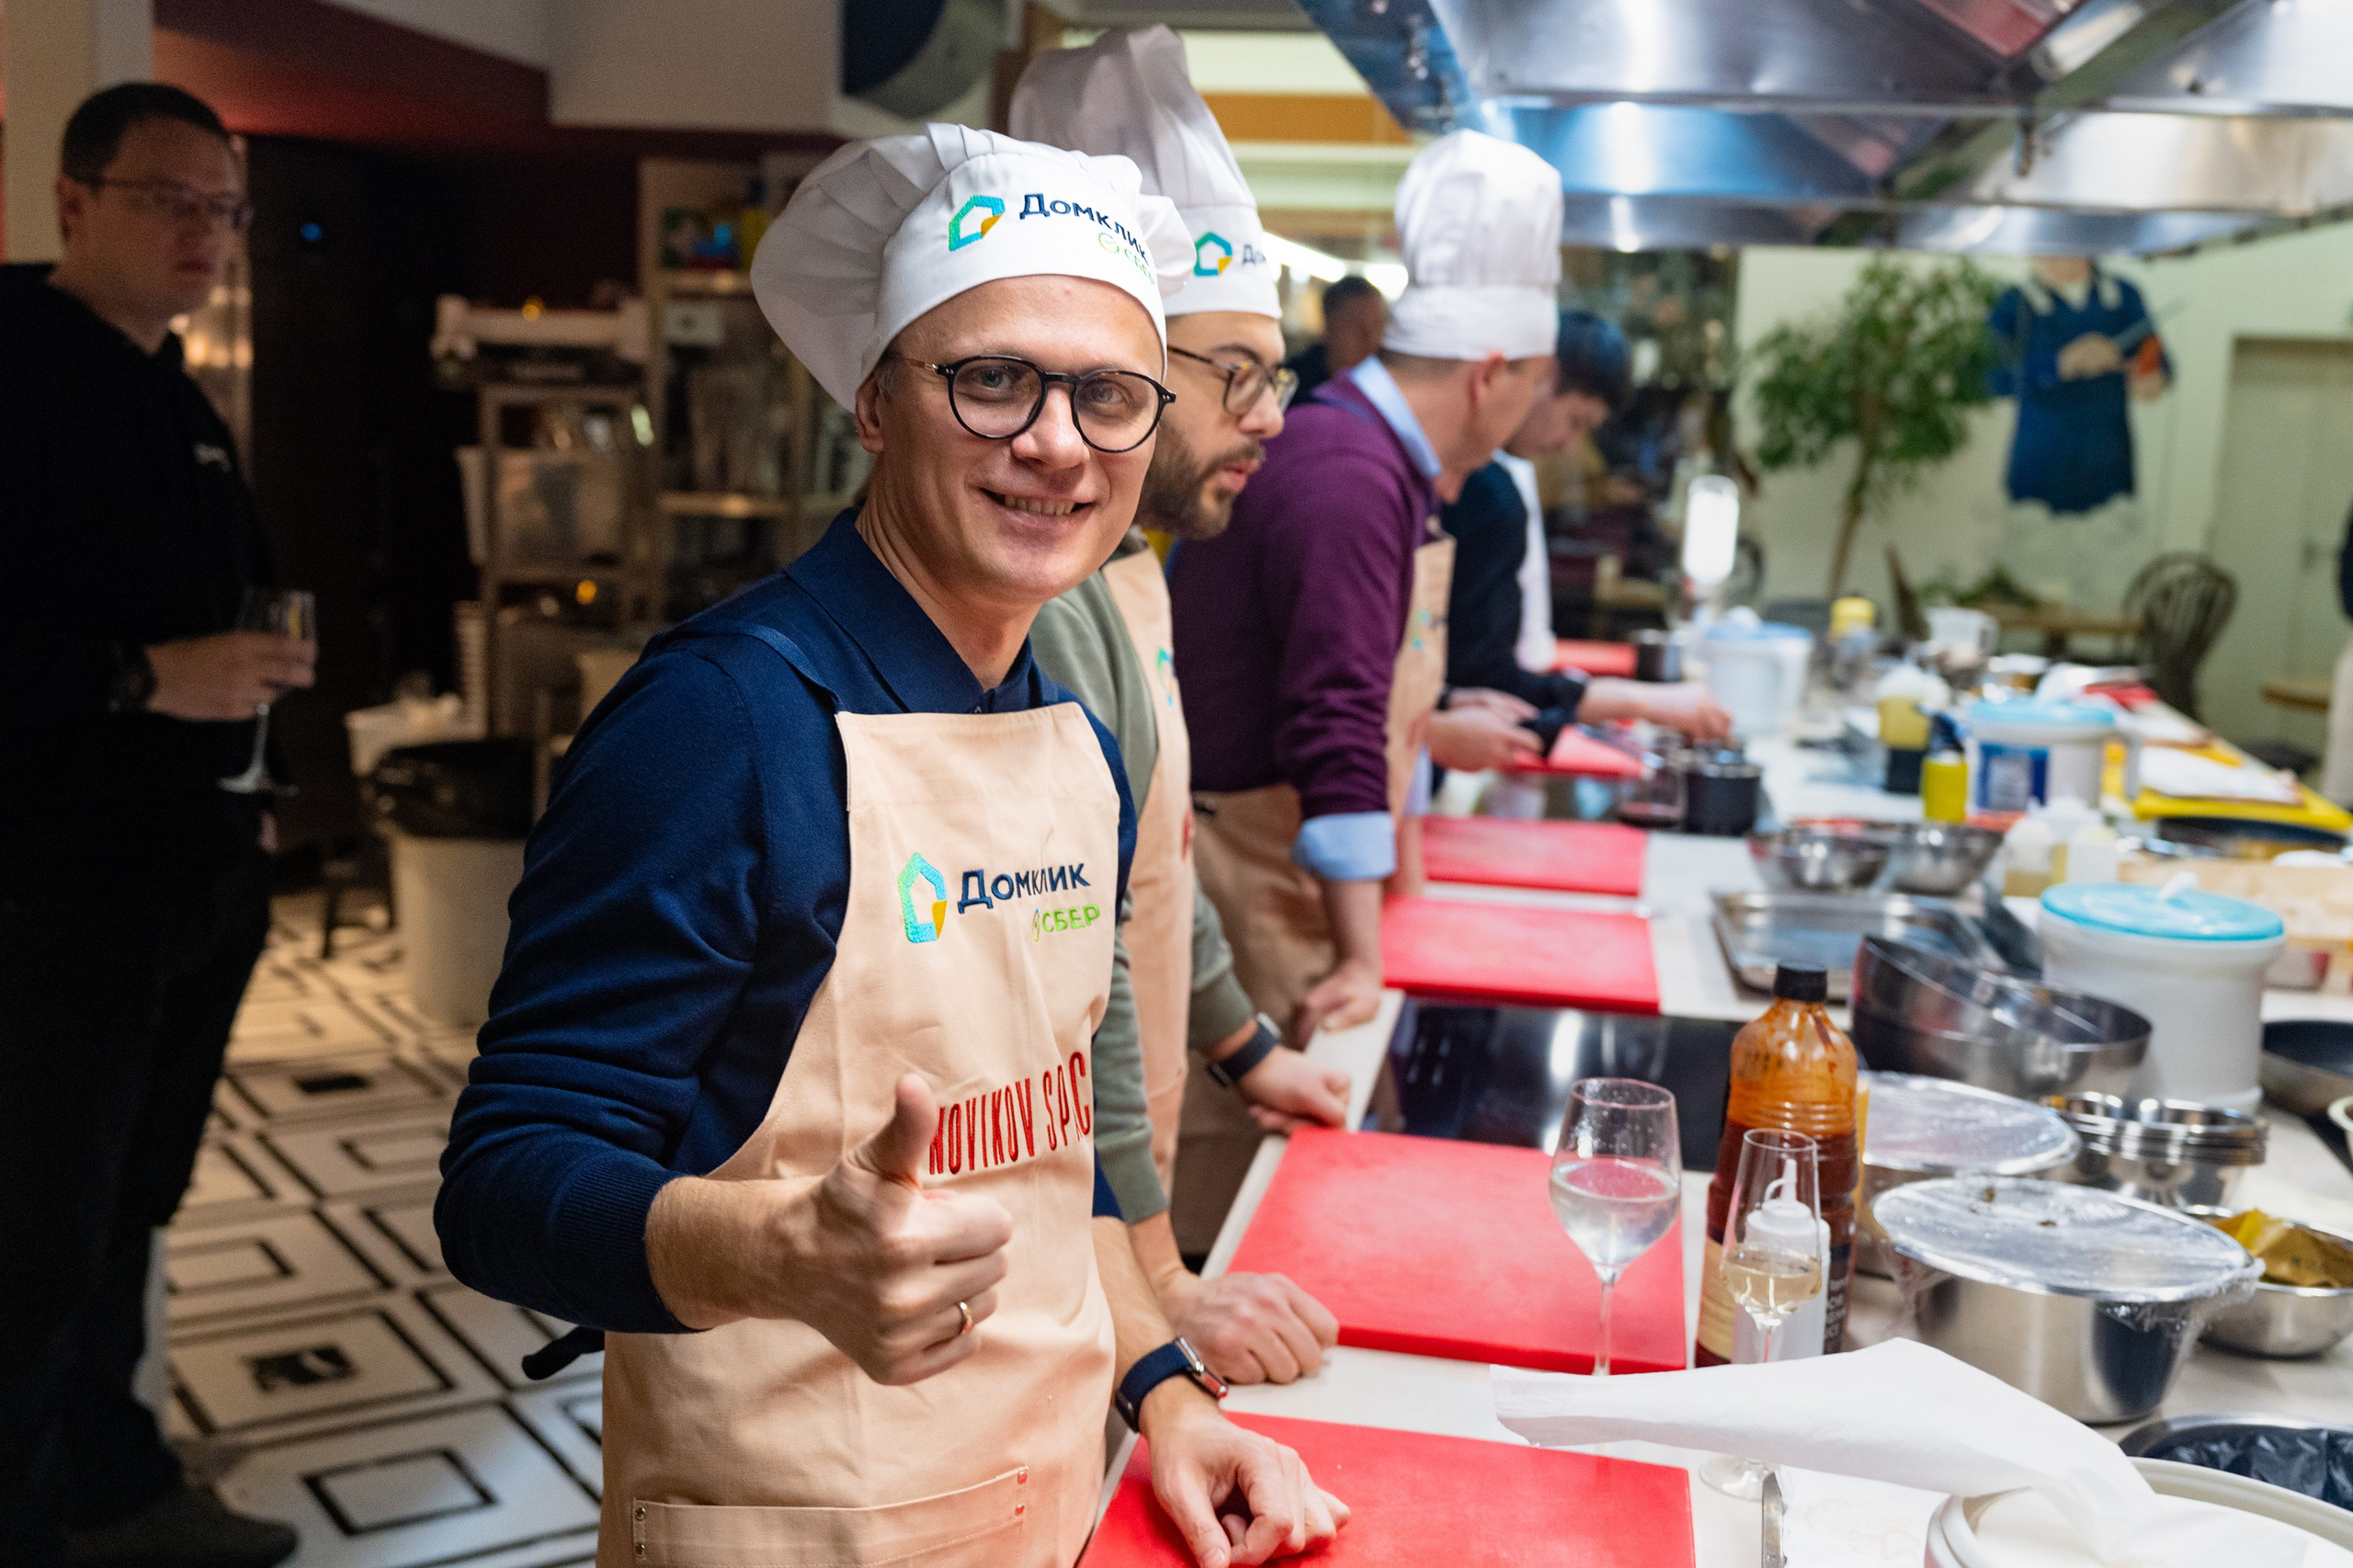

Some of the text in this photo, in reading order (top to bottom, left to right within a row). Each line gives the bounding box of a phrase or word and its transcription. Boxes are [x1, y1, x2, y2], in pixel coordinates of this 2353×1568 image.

[957, 863, 1091, 915] Домклик
[1041, 904, 1100, 933] СБЕР
[929, 1078, 1035, 1176] NOVIKOV
